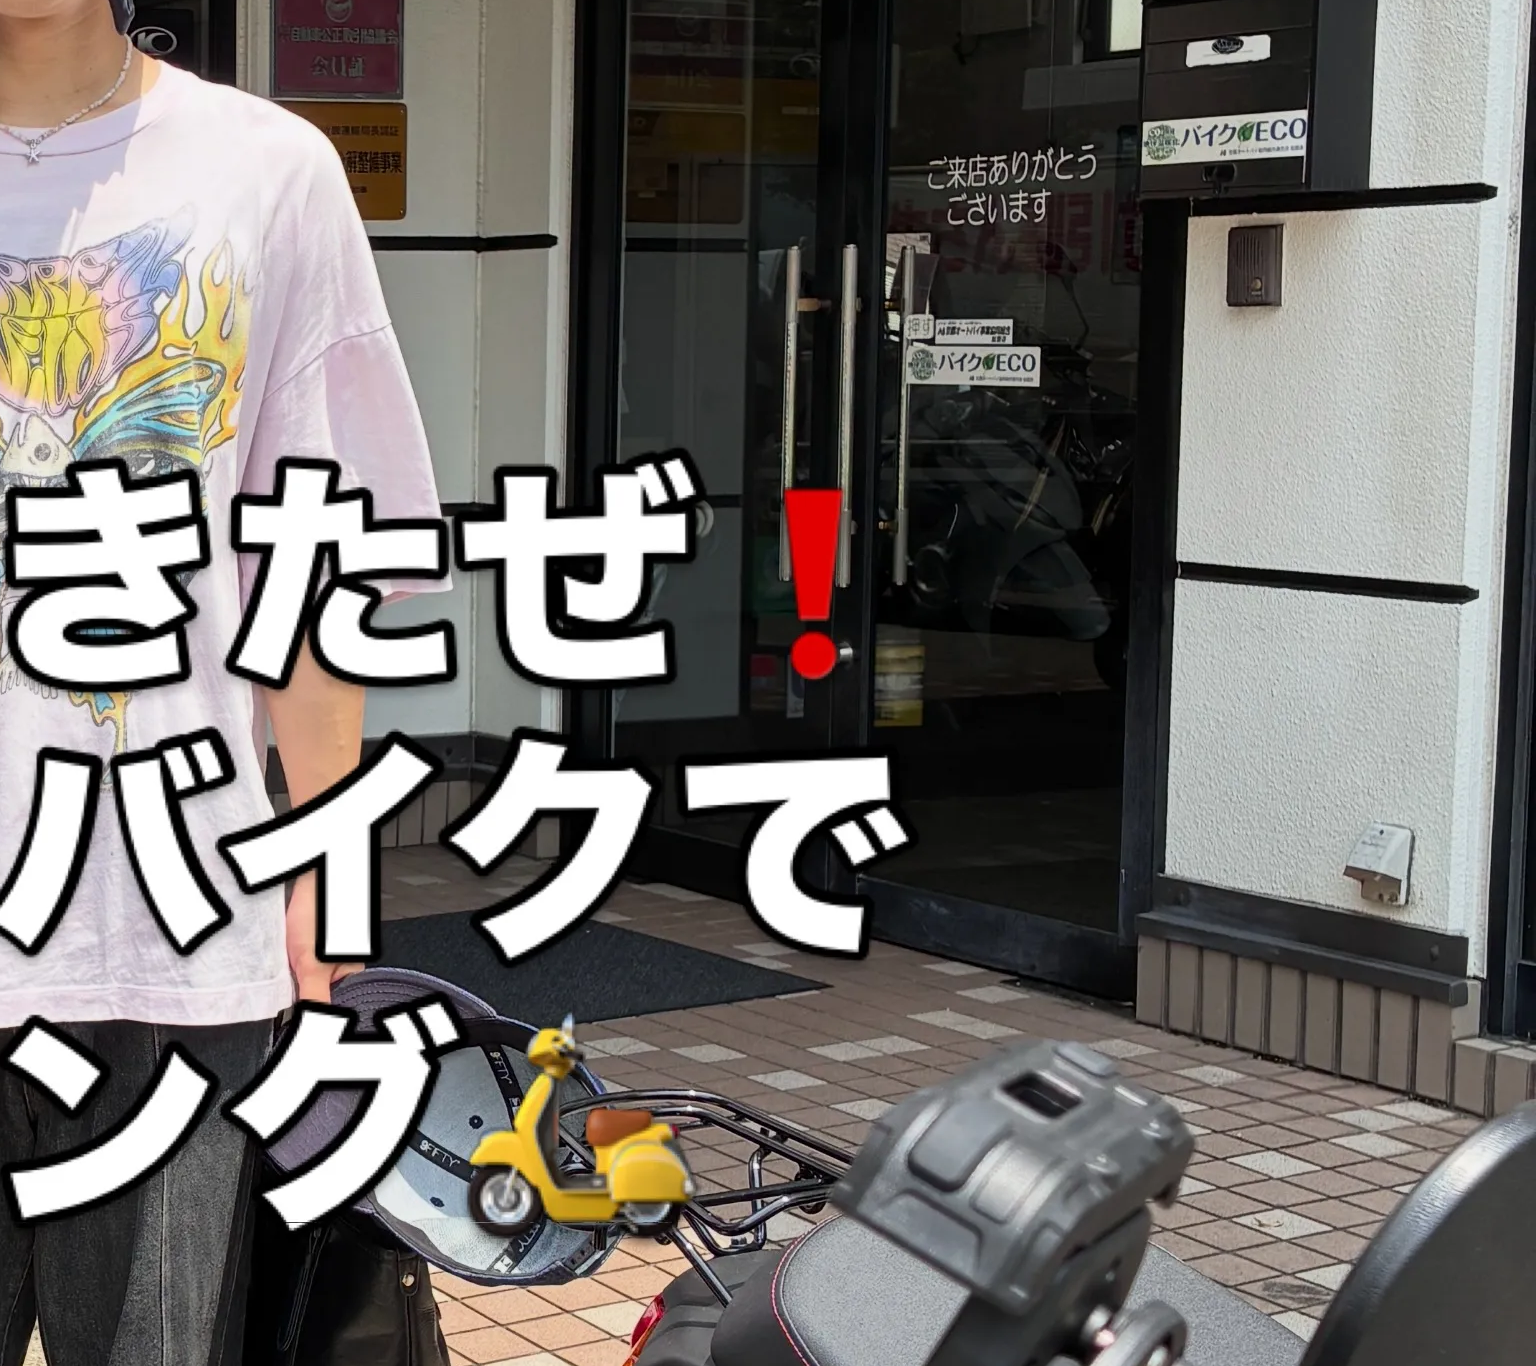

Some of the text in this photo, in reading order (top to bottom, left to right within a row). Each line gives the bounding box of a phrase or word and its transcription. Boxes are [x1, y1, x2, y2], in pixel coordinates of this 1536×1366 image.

[1181, 117, 1307, 148] バイク ECO
[341, 150, 403, 174] 解整備事業
[927, 144, 1097, 190] ご来店ありがとう
[947, 188, 1052, 226] ございます
[938, 350, 983, 373] バイク
[995, 352, 1037, 373] ECO
